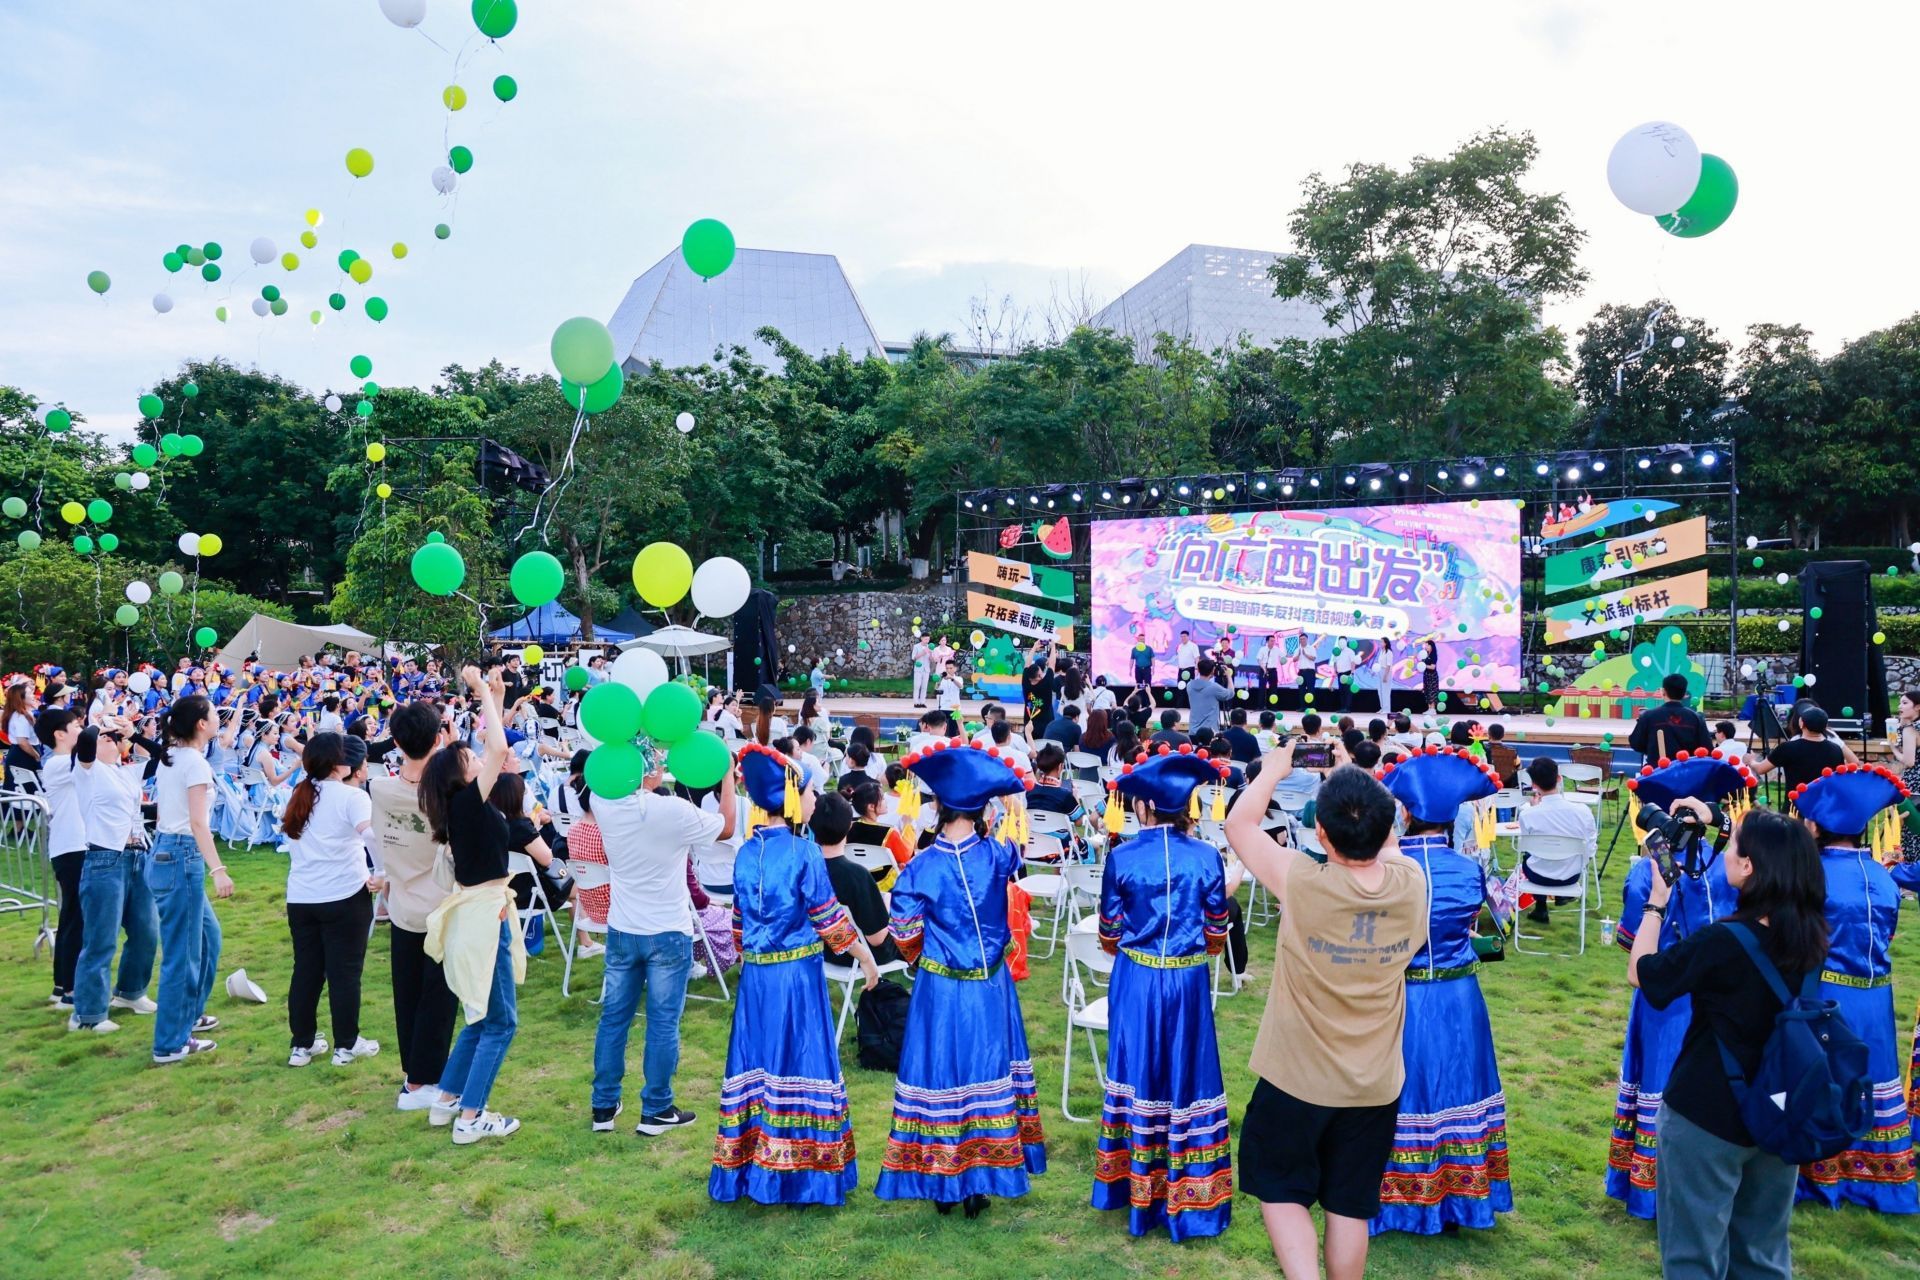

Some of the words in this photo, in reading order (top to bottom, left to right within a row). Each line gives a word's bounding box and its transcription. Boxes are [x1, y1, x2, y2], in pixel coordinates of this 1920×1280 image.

[985, 603, 1056, 633] 开拓幸福旅程
